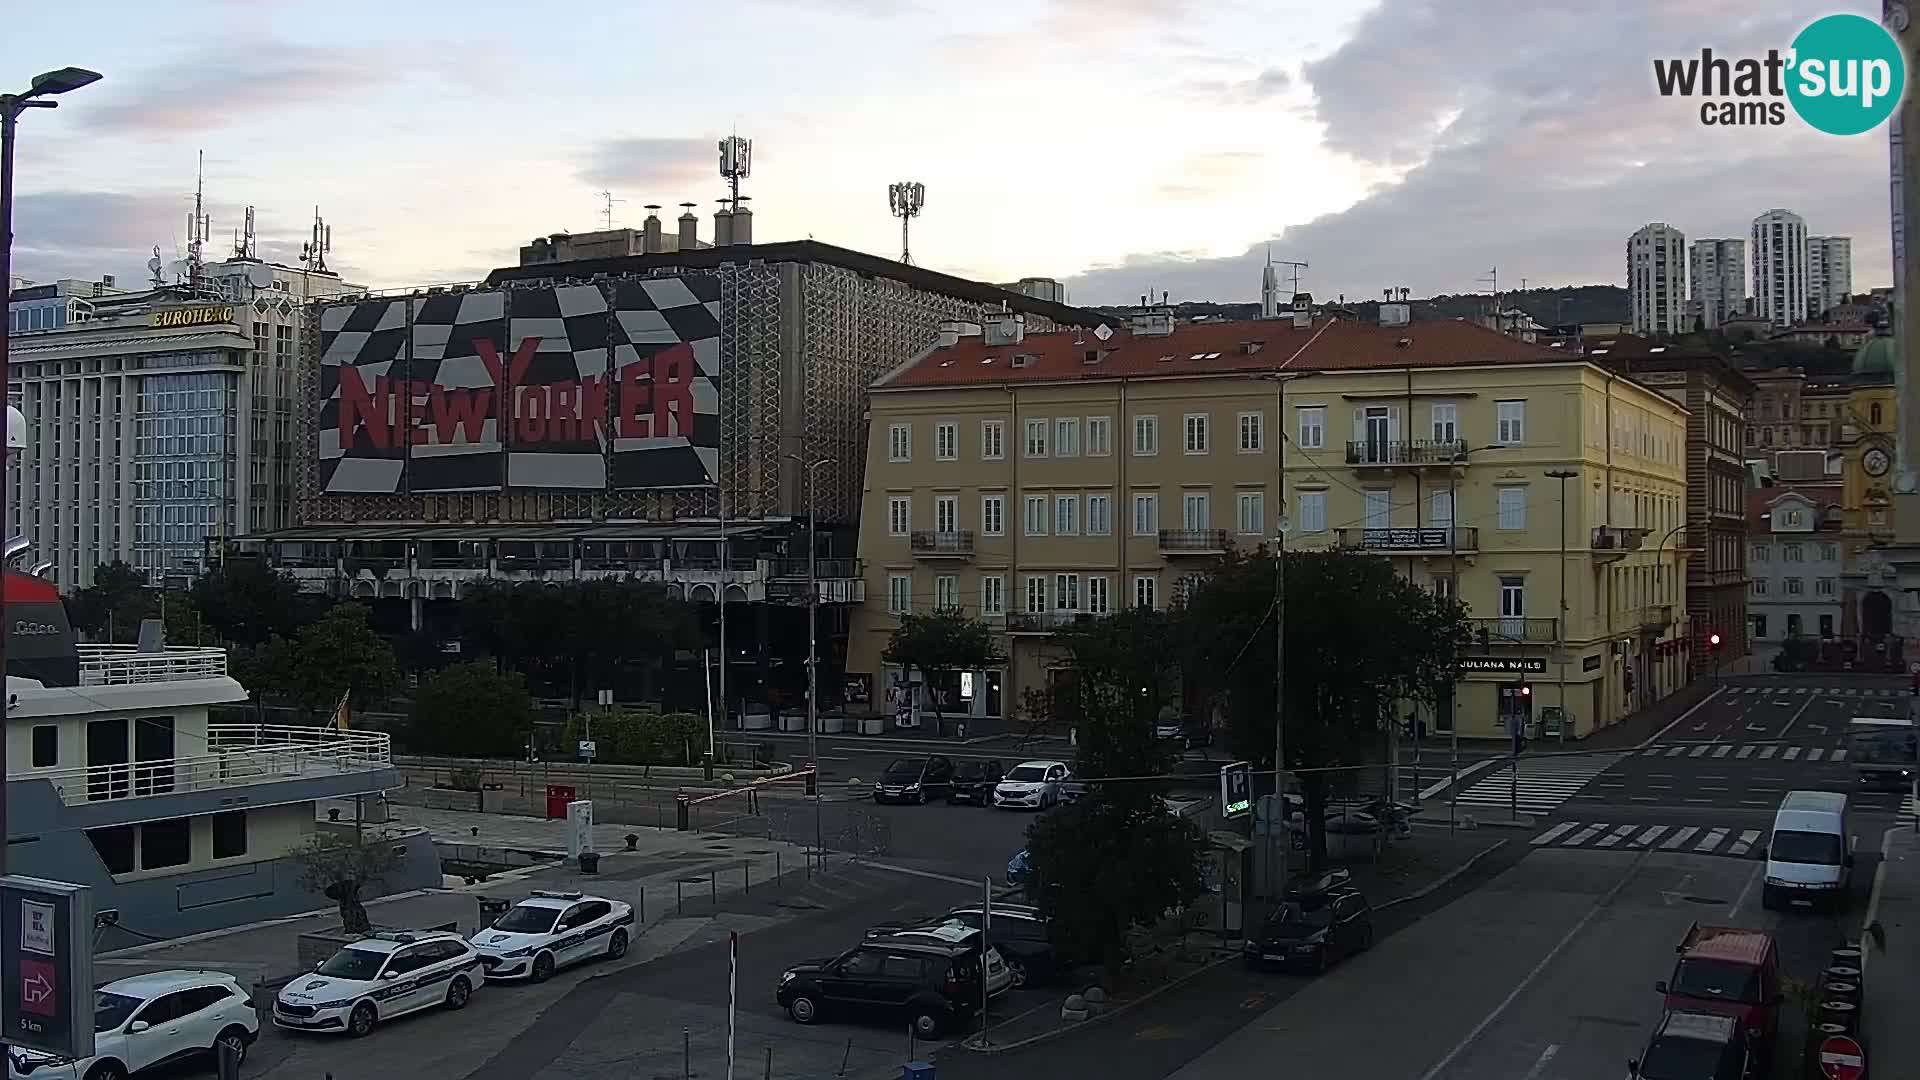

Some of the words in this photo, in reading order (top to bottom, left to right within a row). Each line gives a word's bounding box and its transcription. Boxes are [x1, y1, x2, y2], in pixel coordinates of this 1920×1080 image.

[339, 360, 498, 449] NEW
[473, 336, 694, 443] YORKER
[1458, 660, 1505, 669] JULIANA
[1509, 661, 1541, 669] NAILS
[20, 1018, 27, 1029] 5
[28, 1020, 42, 1032] km
